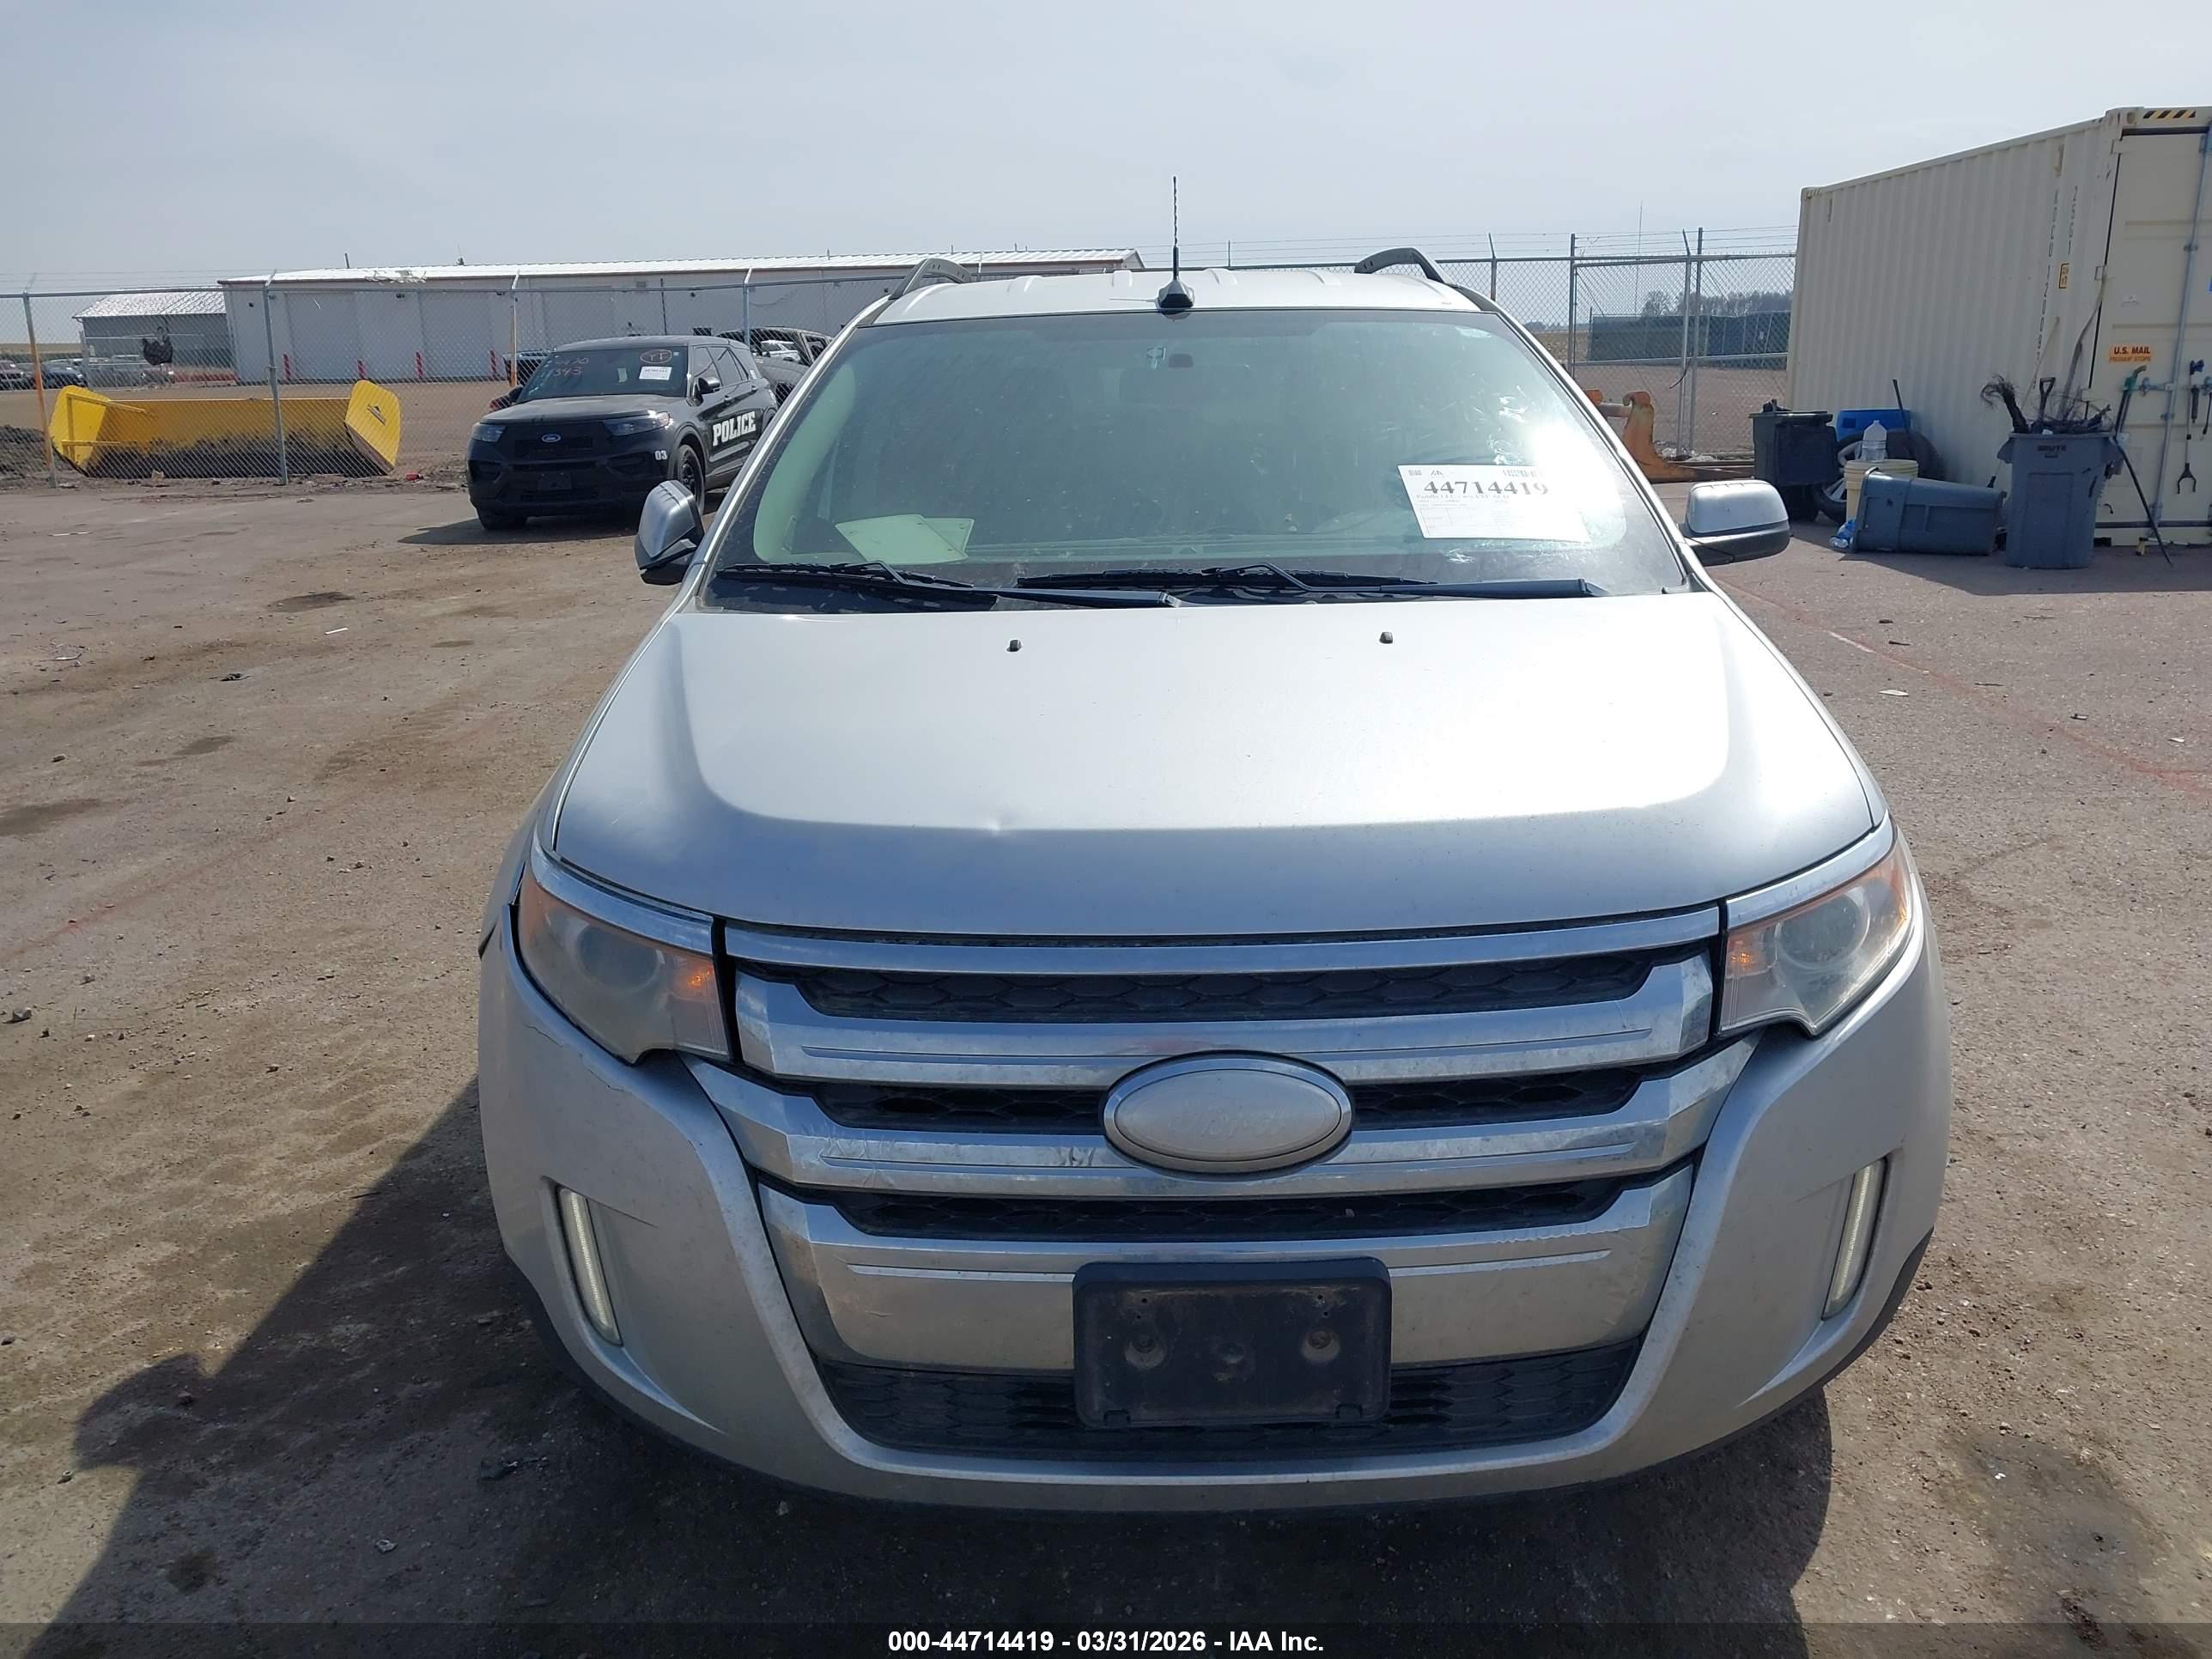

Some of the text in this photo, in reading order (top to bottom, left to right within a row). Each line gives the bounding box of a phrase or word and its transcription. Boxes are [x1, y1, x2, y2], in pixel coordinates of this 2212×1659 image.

[2113, 346, 2129, 355] U.S.
[712, 410, 757, 447] POLICE
[654, 449, 668, 461] 03
[1423, 480, 1549, 495] 44714419
